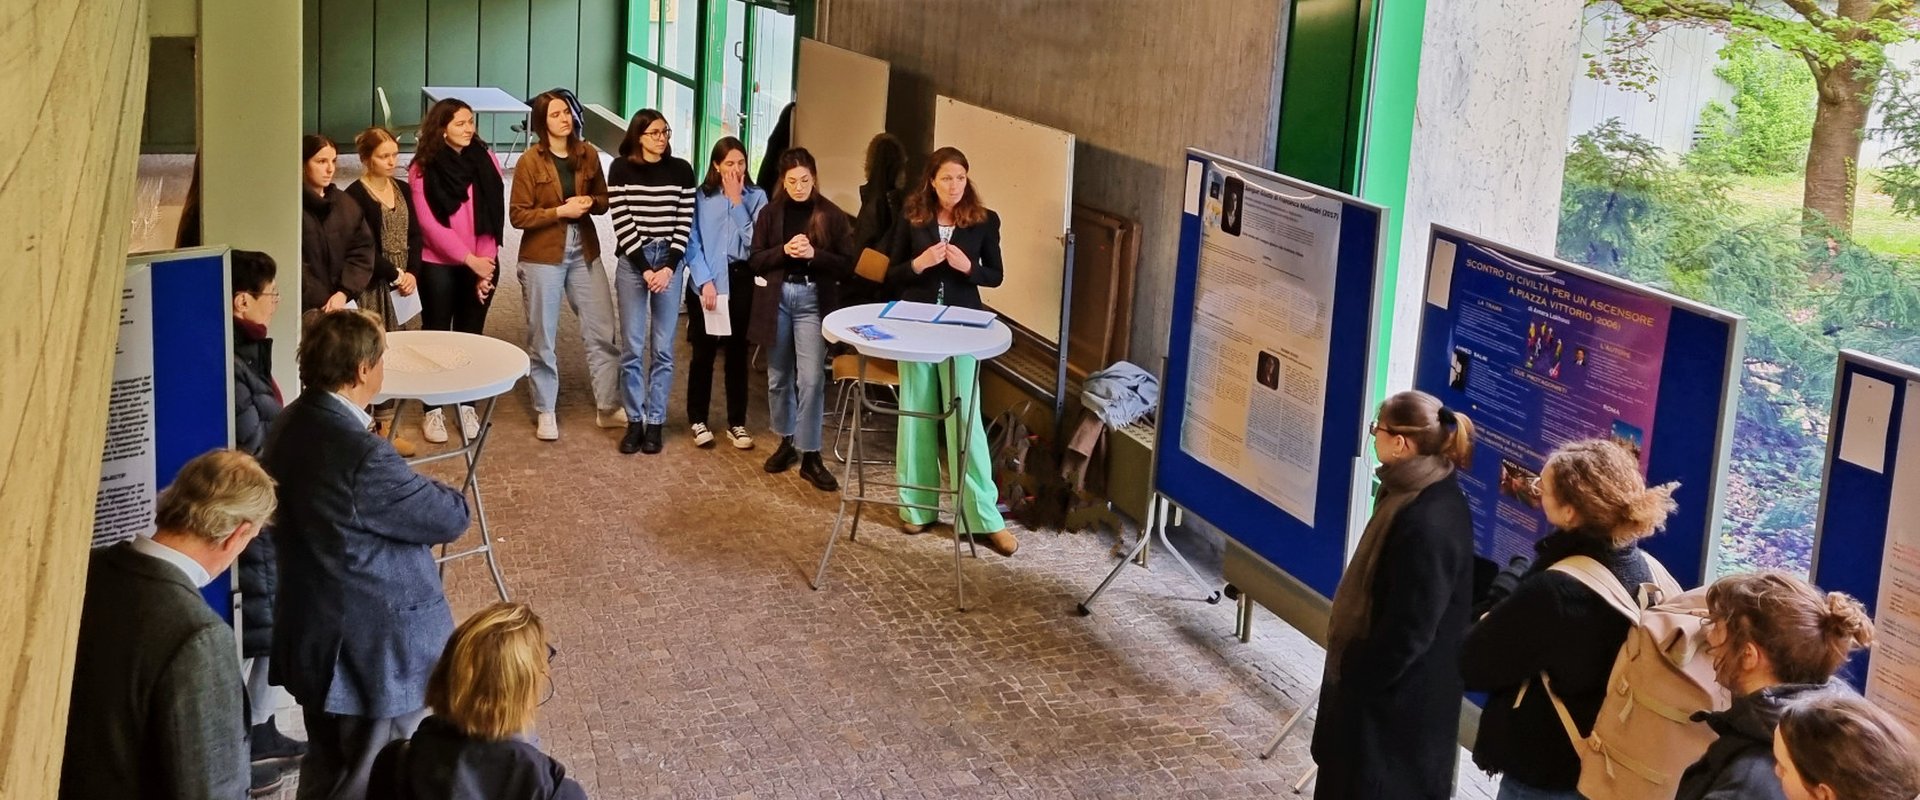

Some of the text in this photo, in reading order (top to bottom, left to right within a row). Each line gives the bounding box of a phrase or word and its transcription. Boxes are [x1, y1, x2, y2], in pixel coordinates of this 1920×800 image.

[1466, 259, 1655, 327] SCONTRO DI CIVILTÀ PER UN ASCENSORE
[1509, 287, 1515, 296] A
[1516, 289, 1547, 307] PIAZZA
[1550, 301, 1593, 321] VITTORIO
